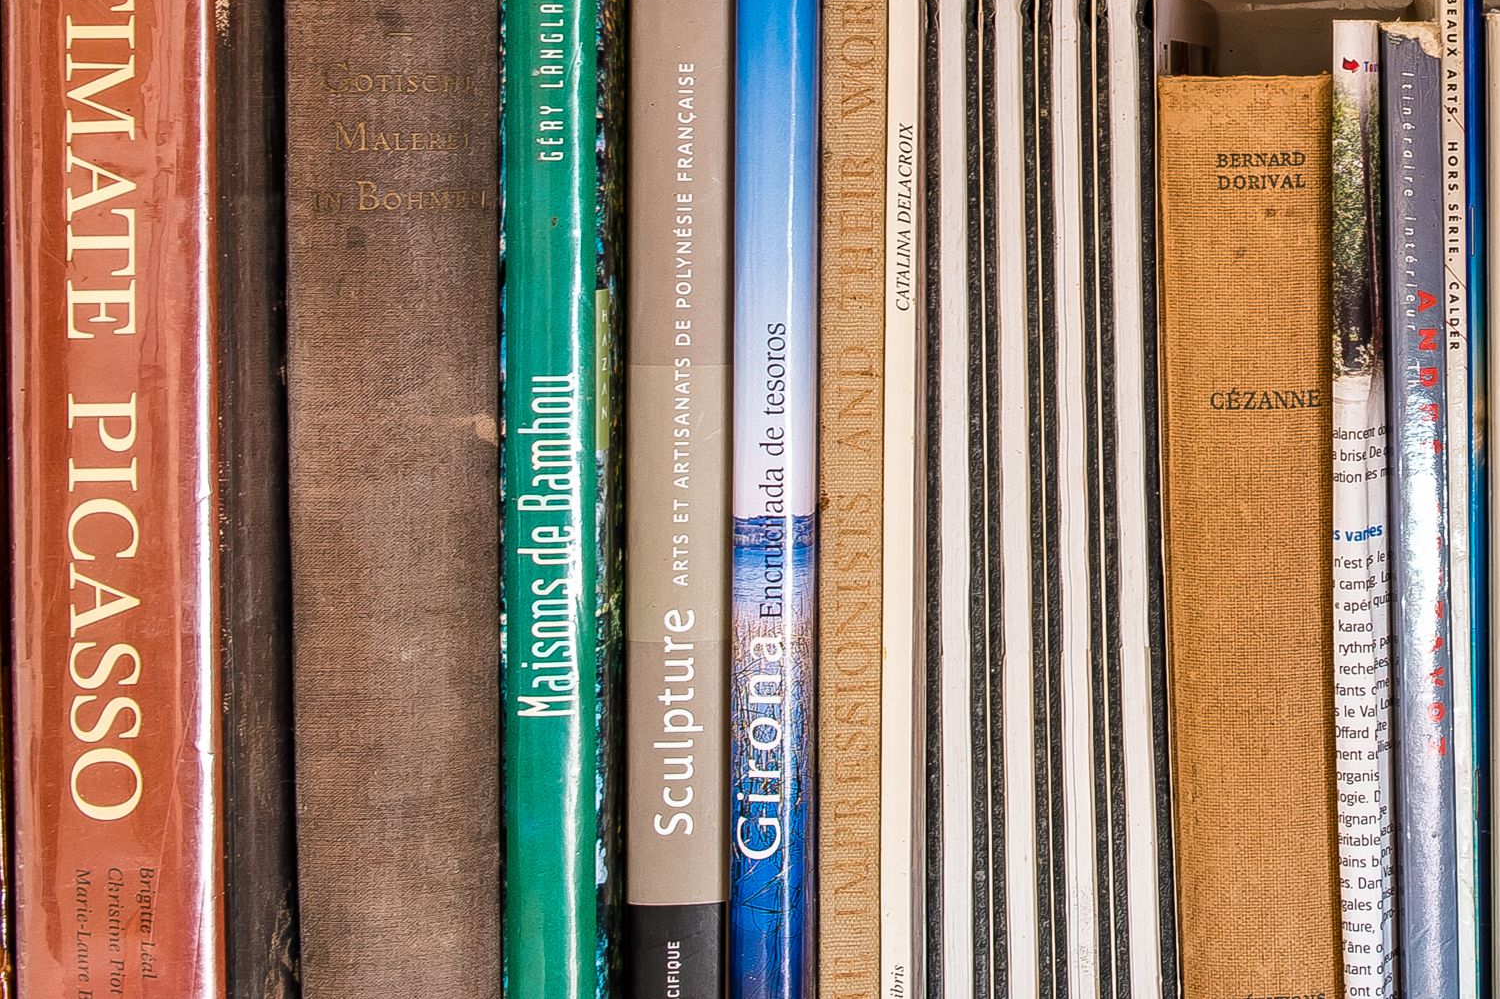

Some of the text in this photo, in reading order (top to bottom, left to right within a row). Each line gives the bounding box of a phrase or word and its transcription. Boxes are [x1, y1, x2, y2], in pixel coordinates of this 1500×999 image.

[539, 98, 565, 163] GÉRY
[1215, 151, 1307, 170] BERNARD
[1401, 71, 1416, 199] Itinéraire
[894, 122, 915, 312] CATALINA DELACROIX
[1216, 172, 1307, 191] DORIVAL
[1448, 281, 1461, 352] CALDER
[516, 372, 578, 515] Bambou
[1208, 387, 1323, 411] CÉZANNE
[66, 392, 144, 823] PICASSO
[653, 607, 705, 839] Sculpture
[736, 632, 791, 861] Girona
[75, 869, 93, 983] Marie-Laure
[107, 867, 125, 953] Christine
[136, 867, 157, 934] Brigitte
